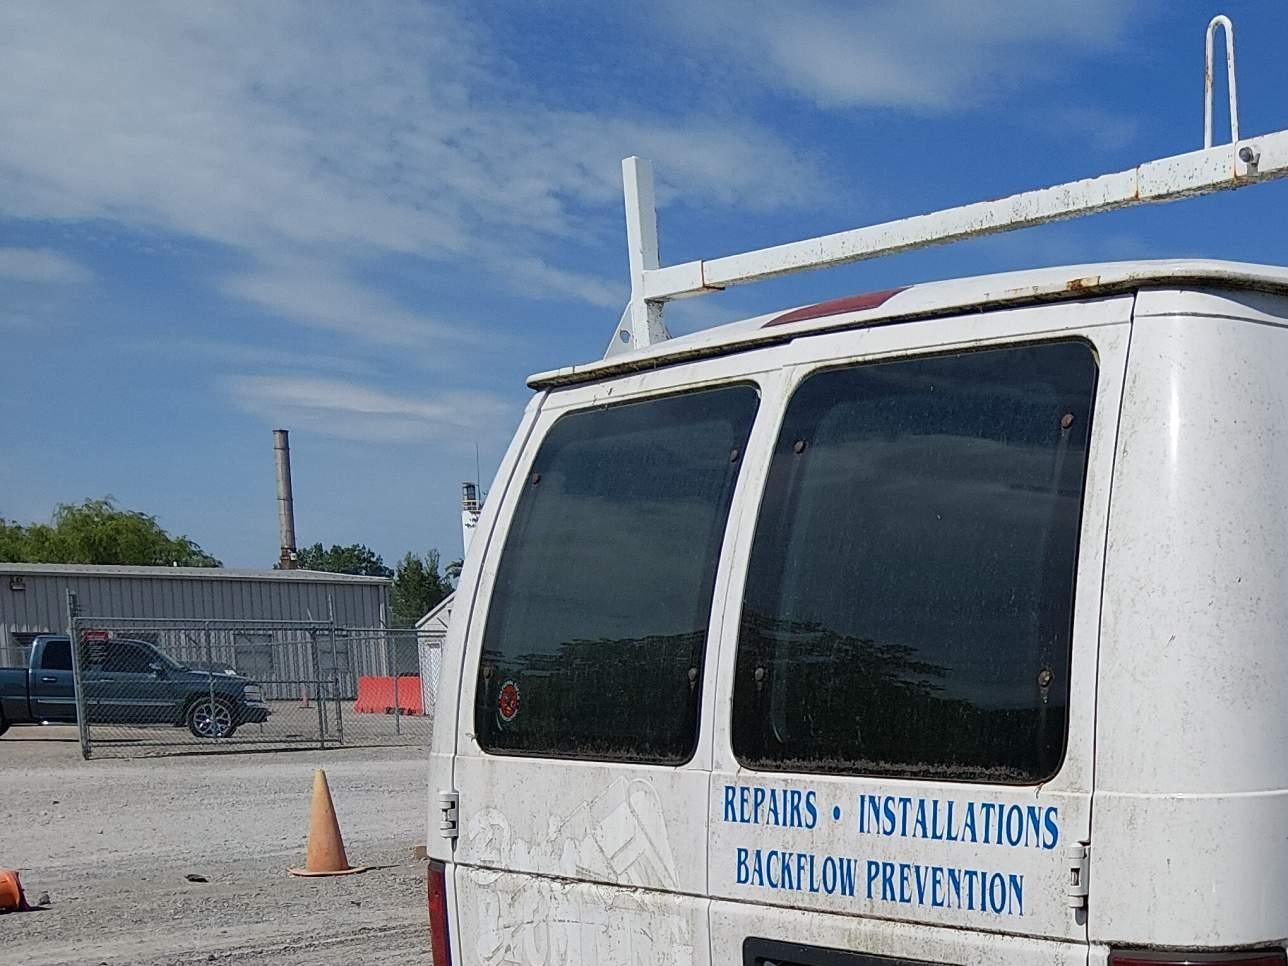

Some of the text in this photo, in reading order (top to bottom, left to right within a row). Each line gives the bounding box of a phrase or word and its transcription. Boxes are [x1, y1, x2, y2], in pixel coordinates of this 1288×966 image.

[723, 785, 818, 830] REPAIRS
[859, 794, 1059, 850] INSTALLATIONS
[735, 847, 1025, 917] BACKFLOW PREVENTION
